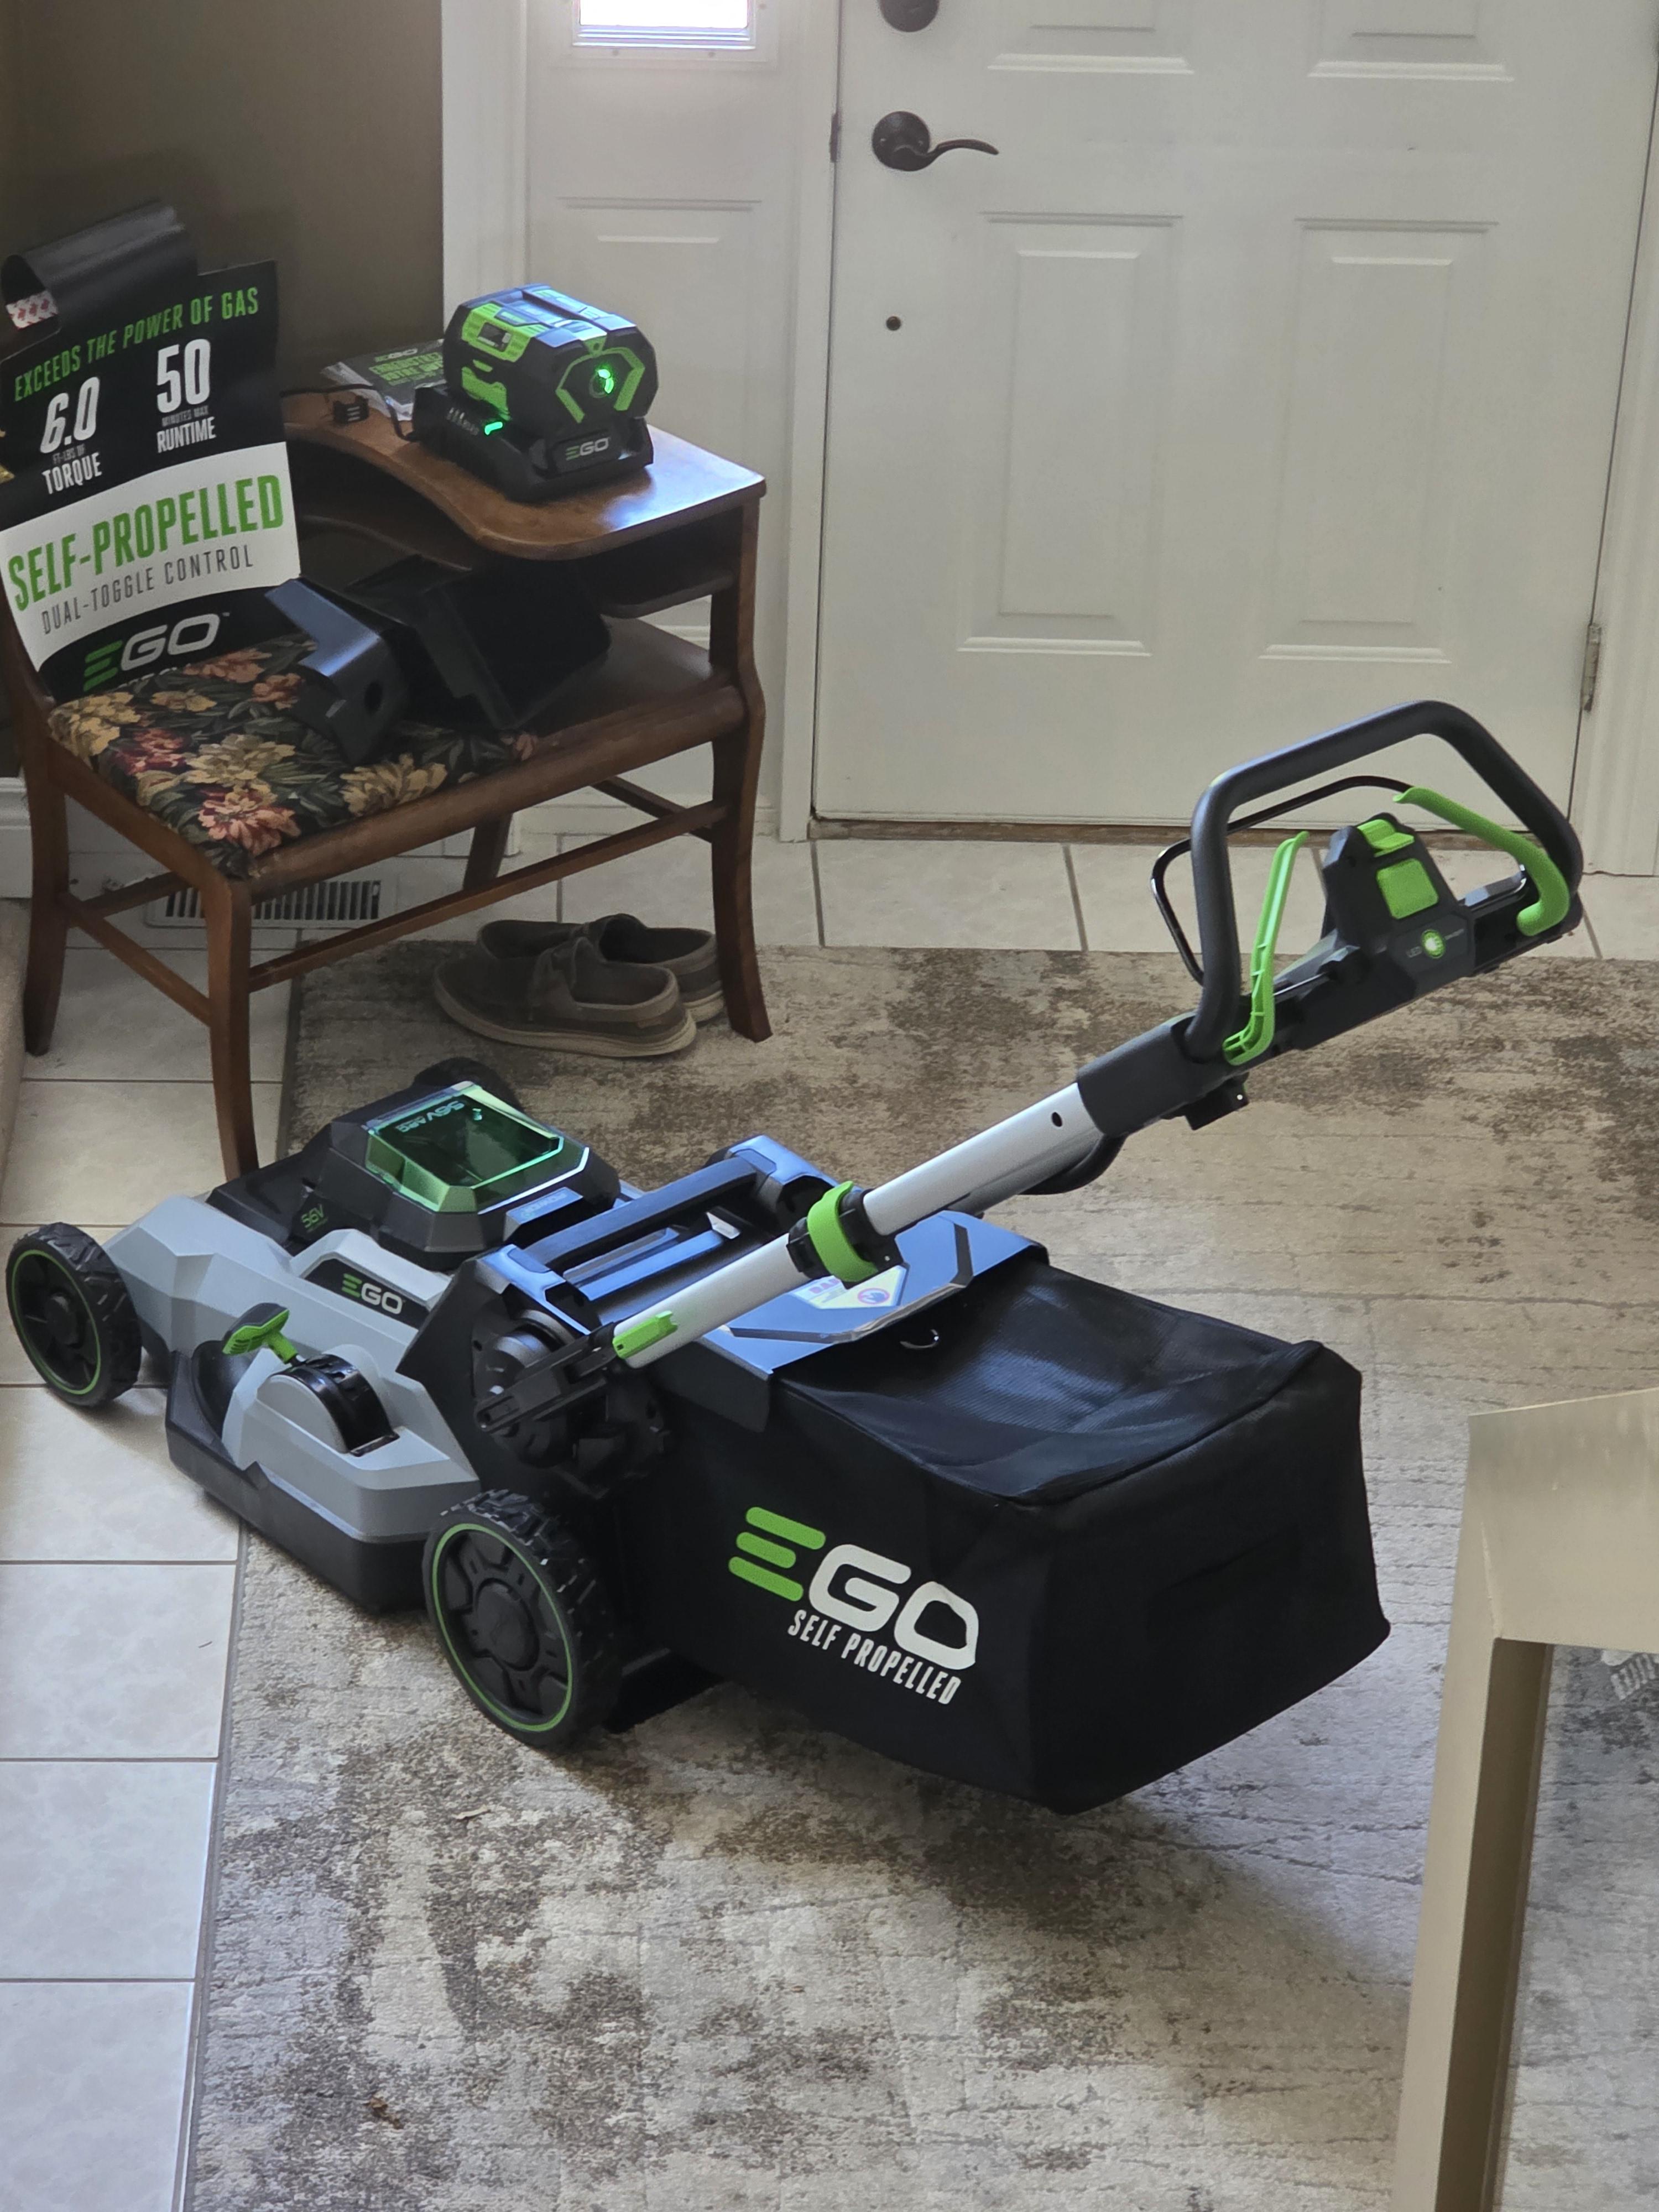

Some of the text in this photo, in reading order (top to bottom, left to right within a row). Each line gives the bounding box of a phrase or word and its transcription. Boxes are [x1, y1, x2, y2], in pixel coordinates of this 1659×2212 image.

[15, 286, 258, 402] EXCEEDS THE POWER OF GAS
[156, 338, 211, 413] 50
[40, 377, 100, 453] 6.0
[157, 416, 216, 453] RUNTIME
[565, 437, 609, 461] EGO
[41, 451, 102, 494] TORQUE
[8, 474, 284, 611] SELF-PROPELLED
[41, 544, 254, 635] DUAL-TOGGLE CONTROL
[82, 613, 221, 692] EGO
[301, 1203, 324, 1228] 56V
[341, 1272, 403, 1315] EGO
[728, 1506, 979, 1671] EGO
[787, 1609, 962, 1705] SELF PROPELLED
